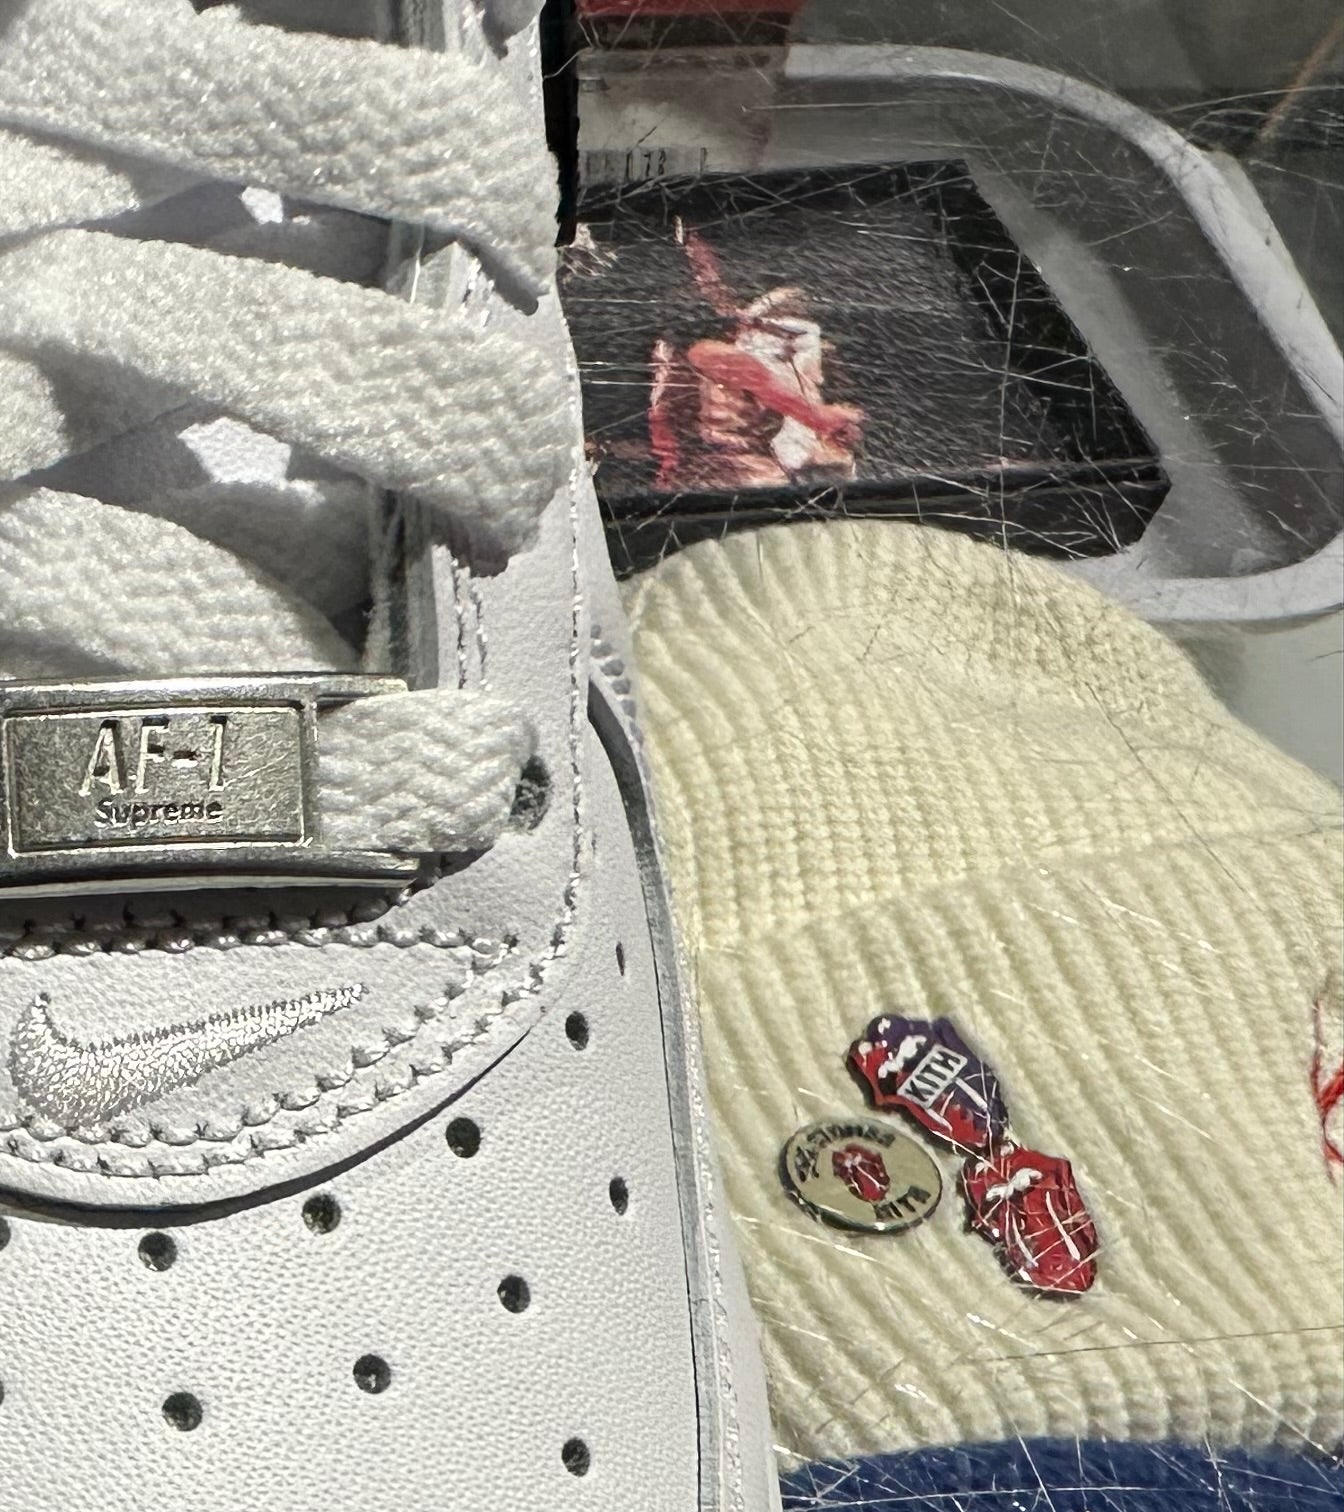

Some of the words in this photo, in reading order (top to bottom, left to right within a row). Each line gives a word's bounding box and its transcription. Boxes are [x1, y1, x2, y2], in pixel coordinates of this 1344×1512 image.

[78, 715, 228, 797] AF-1
[94, 799, 225, 835] Supreme
[904, 1049, 961, 1104] KITH
